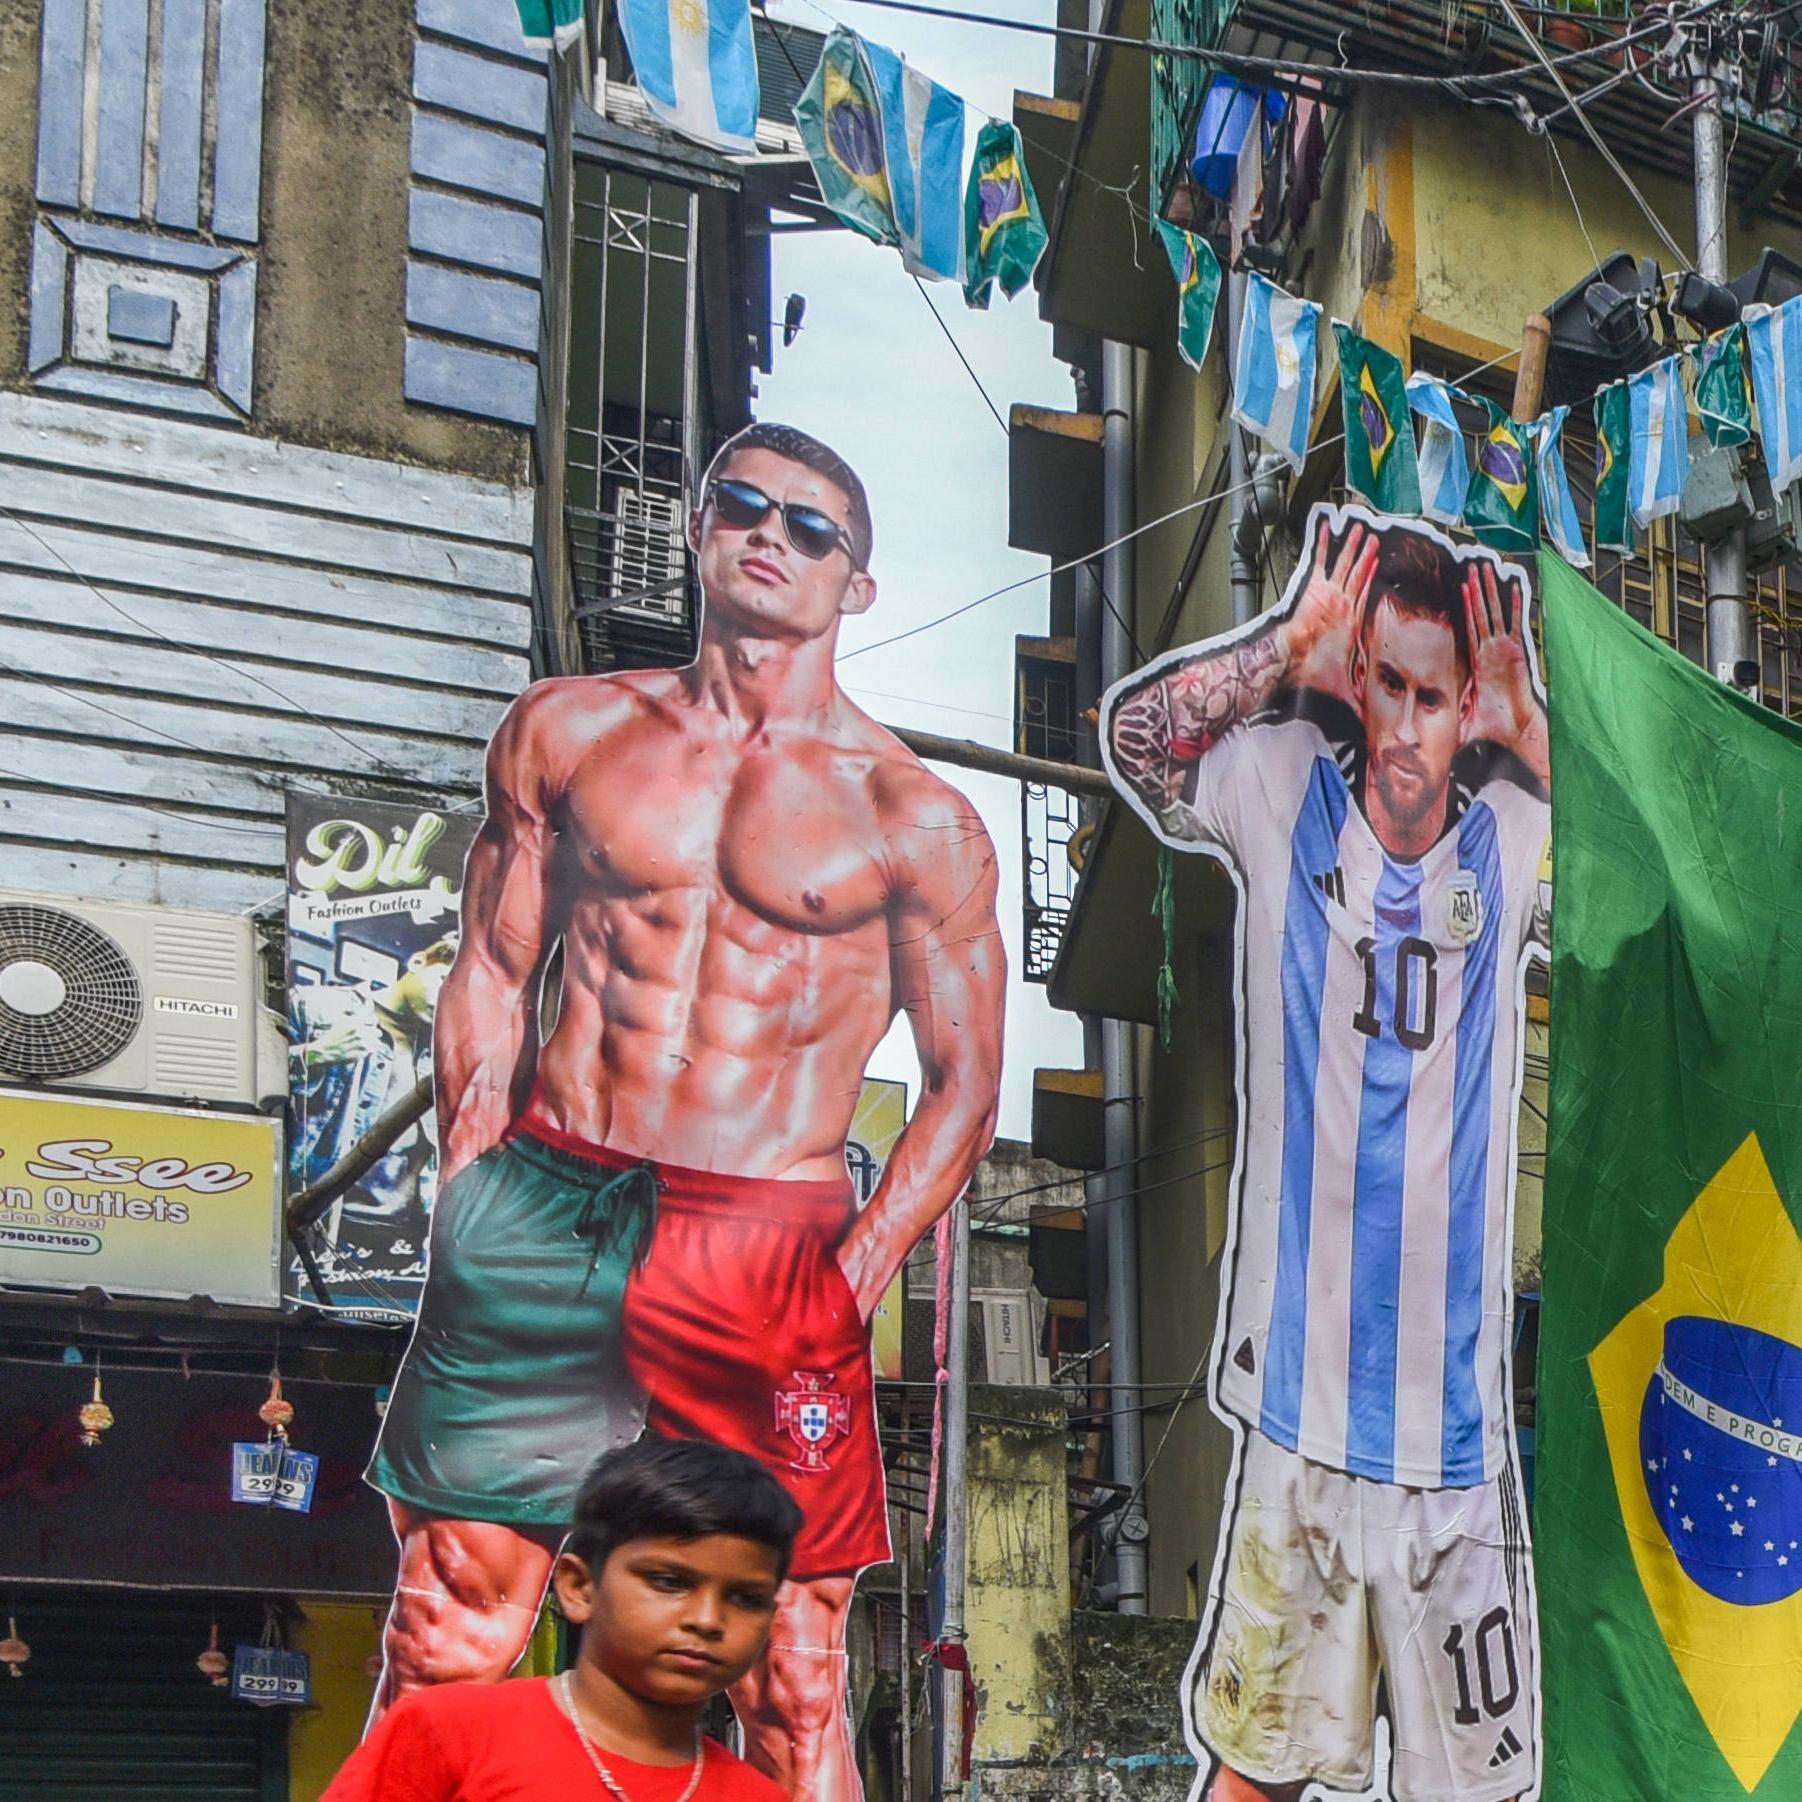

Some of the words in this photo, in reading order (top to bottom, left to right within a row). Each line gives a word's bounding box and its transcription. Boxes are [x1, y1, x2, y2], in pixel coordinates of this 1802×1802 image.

[307, 904, 364, 921] Fashion
[369, 897, 424, 915] Outlets
[159, 999, 234, 1018] HITACHI
[1353, 935, 1440, 1051] 10
[25, 1139, 253, 1194] Ssee
[45, 1185, 189, 1225] Outlets
[45, 1213, 105, 1231] Street
[1663, 1373, 1695, 1409] DEM
[1706, 1405, 1716, 1422] E
[244, 1677, 276, 1690] 299
[1442, 1604, 1519, 1728] 10
